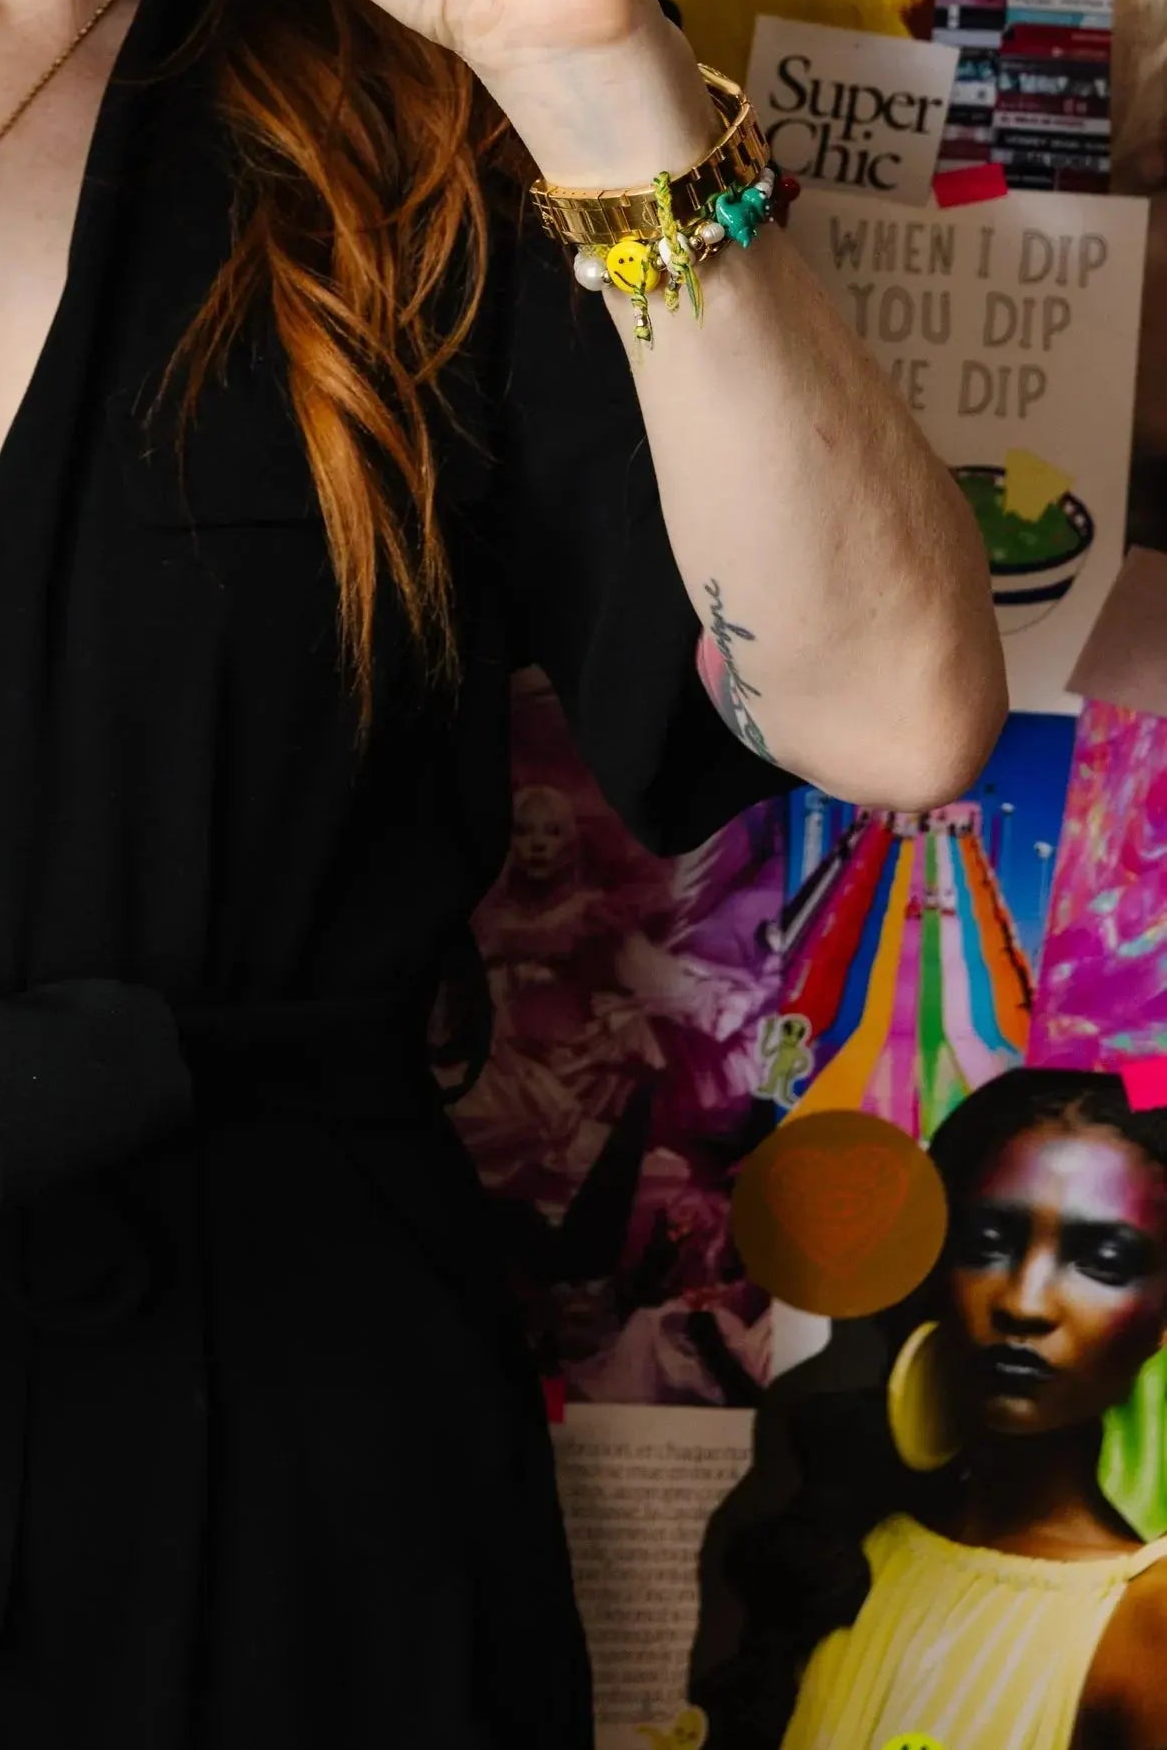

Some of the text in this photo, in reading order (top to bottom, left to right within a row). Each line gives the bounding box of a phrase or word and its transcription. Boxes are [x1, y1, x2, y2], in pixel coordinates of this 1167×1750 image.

[768, 55, 945, 143] Super
[765, 116, 902, 191] Chic
[829, 215, 1109, 289] WHEN I DIP
[847, 281, 1072, 351] YOU DIP
[890, 358, 1049, 419] E DIP
